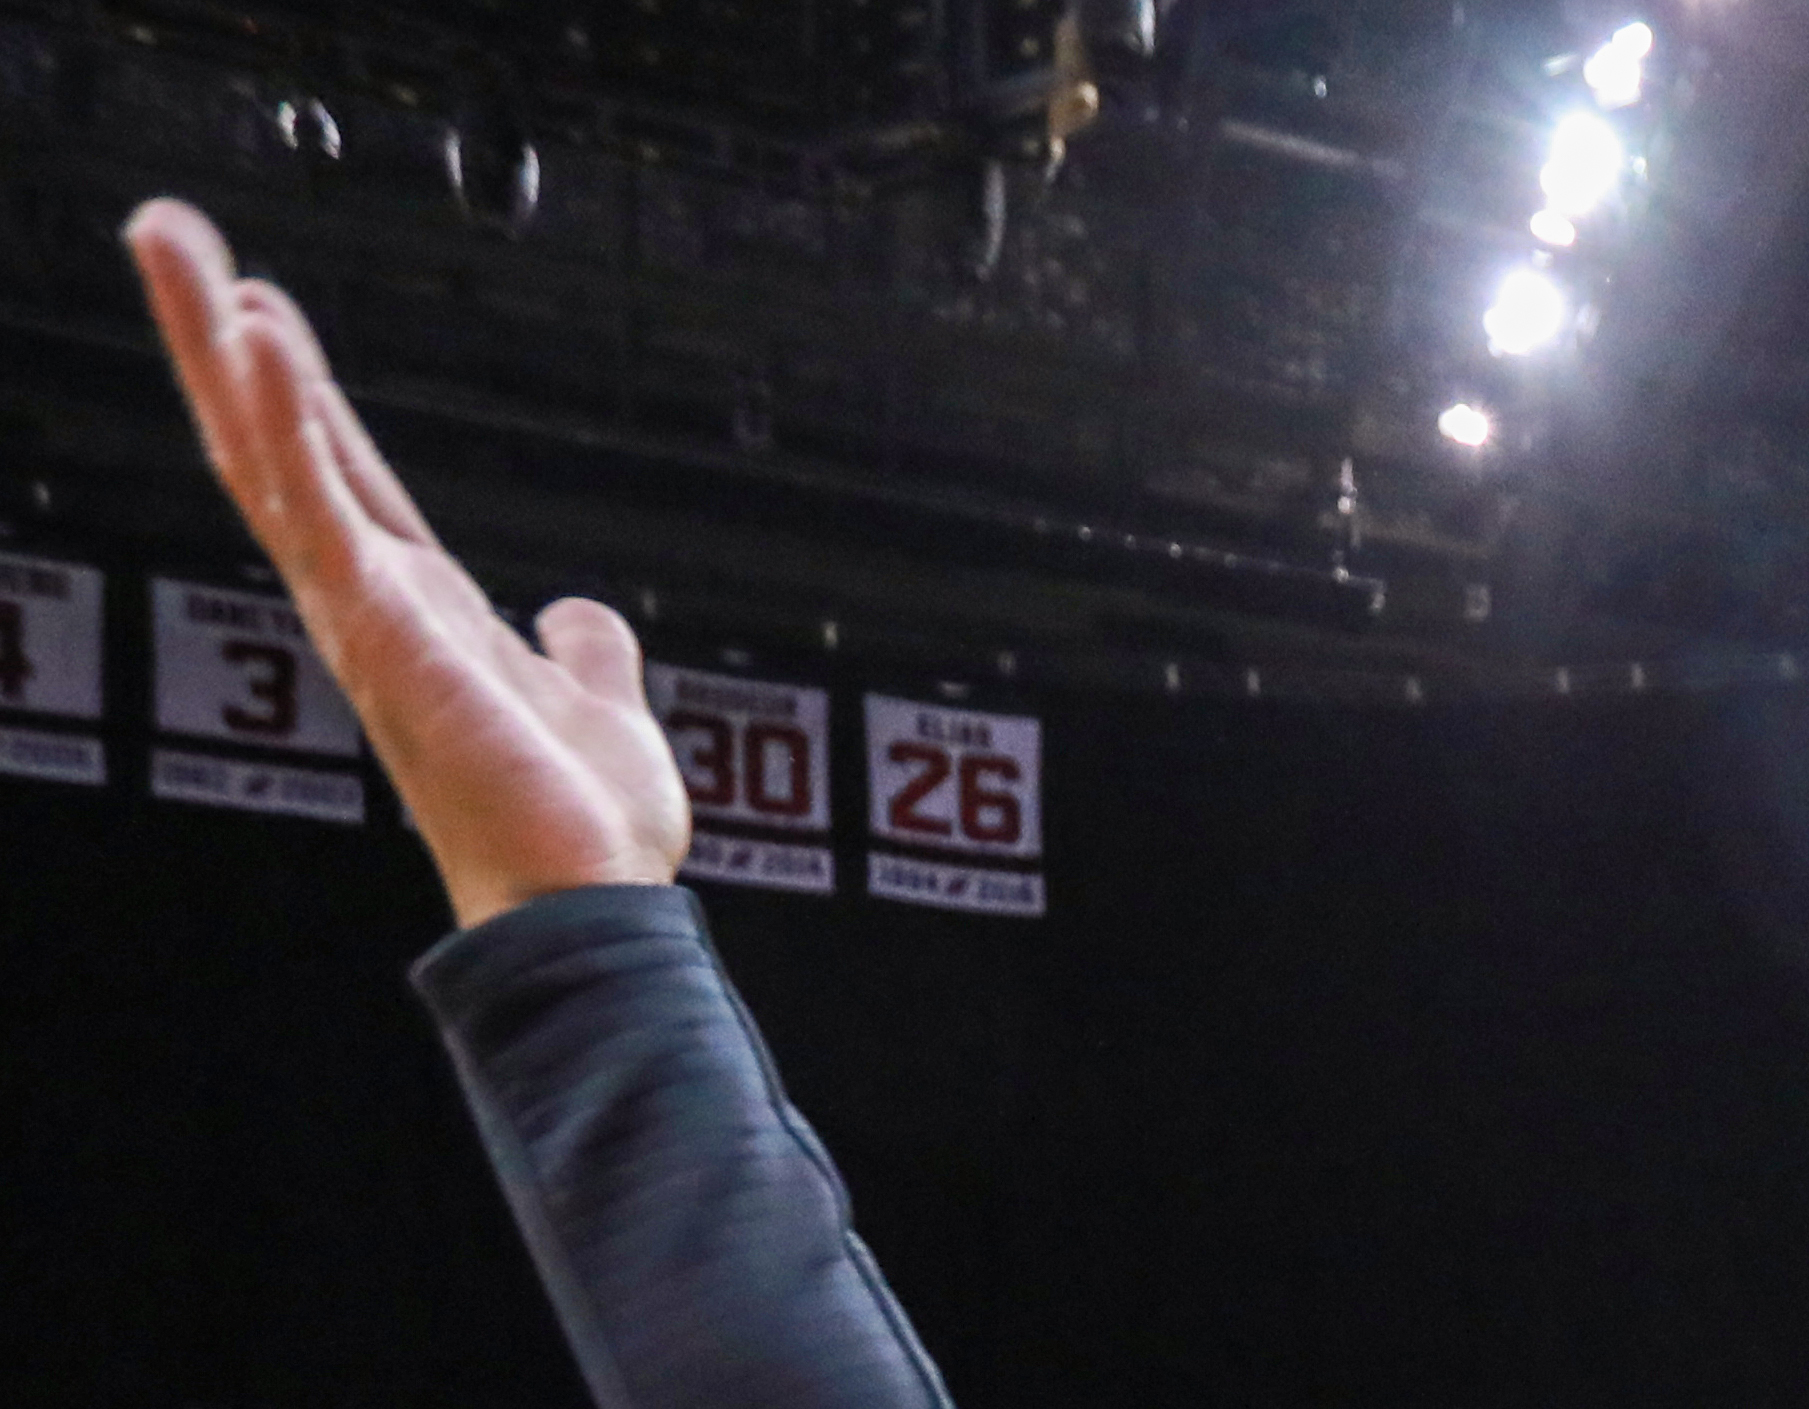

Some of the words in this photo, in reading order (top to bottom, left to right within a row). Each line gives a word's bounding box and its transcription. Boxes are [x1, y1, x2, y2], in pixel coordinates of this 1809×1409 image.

[222, 640, 298, 737] 3
[668, 708, 811, 816] 30
[889, 740, 1022, 843] 26
